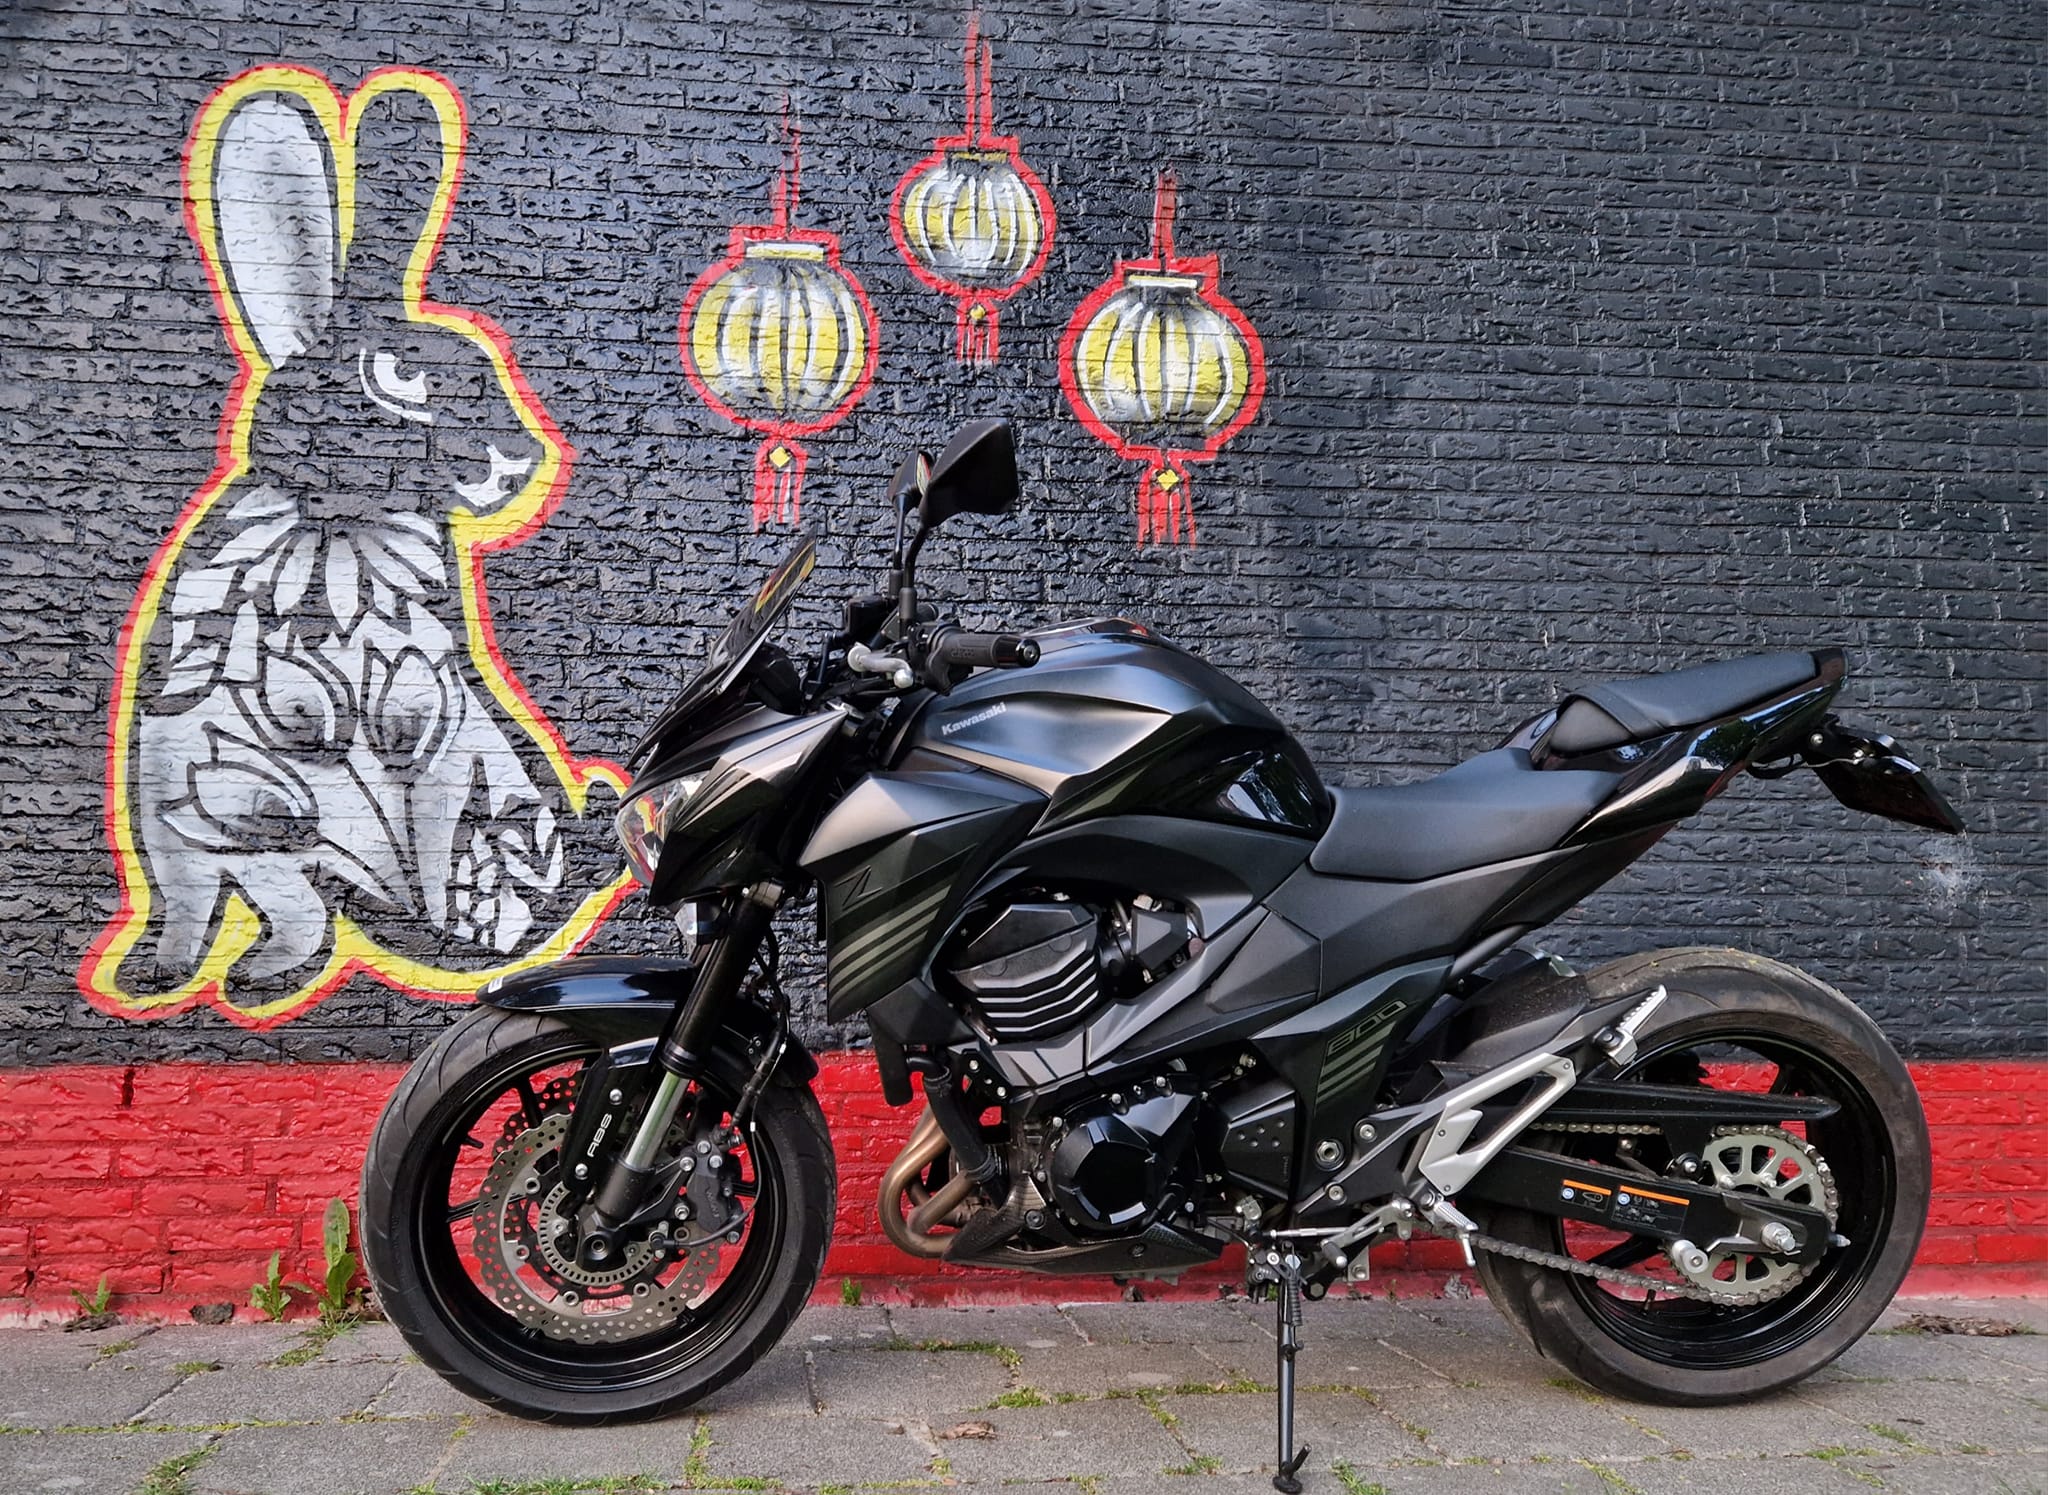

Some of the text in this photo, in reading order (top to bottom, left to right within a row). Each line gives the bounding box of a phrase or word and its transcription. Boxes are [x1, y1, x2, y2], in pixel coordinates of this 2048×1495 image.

[941, 702, 1007, 735] Kawasaki
[1327, 1000, 1407, 1056] 800
[587, 1113, 612, 1158] ABS
